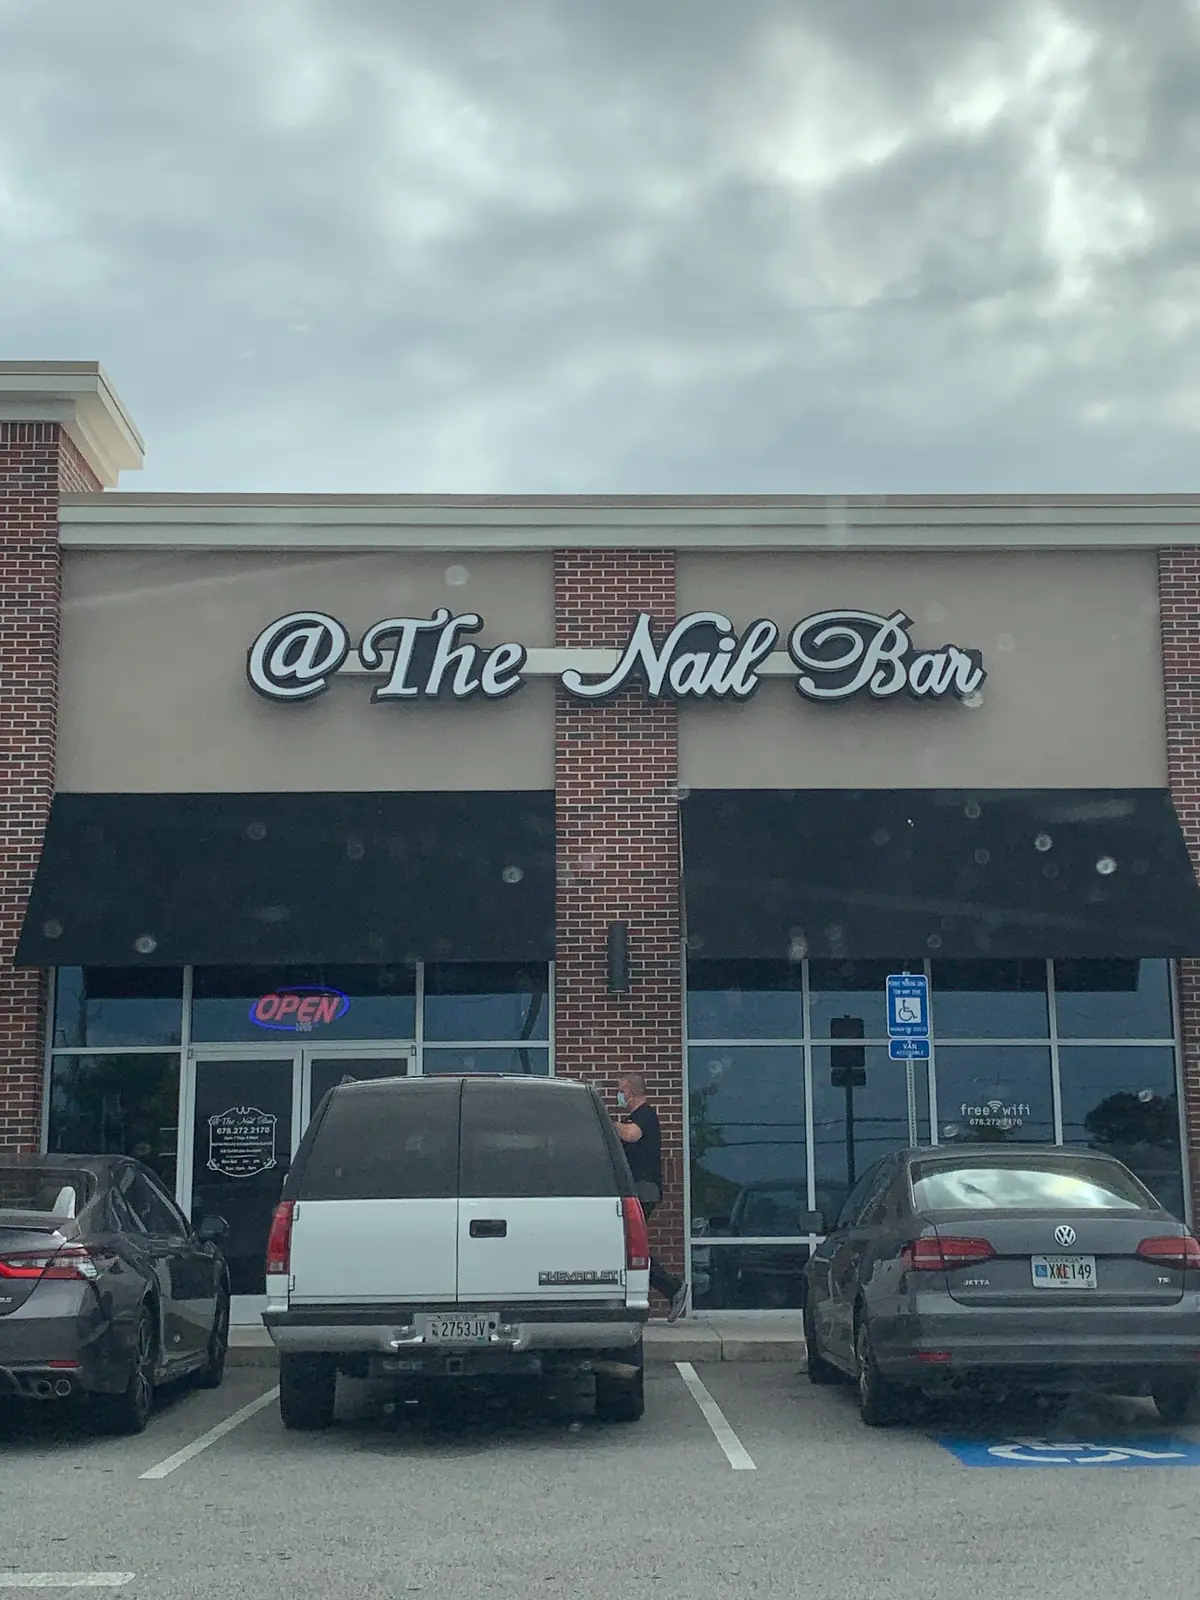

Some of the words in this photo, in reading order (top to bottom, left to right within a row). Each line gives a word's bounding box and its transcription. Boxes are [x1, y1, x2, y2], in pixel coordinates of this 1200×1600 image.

[248, 610, 347, 698] @
[360, 607, 526, 698] The
[560, 610, 780, 698] Nail
[790, 609, 985, 699] Bar
[255, 993, 340, 1024] OPEN
[960, 1103, 990, 1116] free
[1002, 1103, 1031, 1116] wifi
[539, 1270, 618, 1281] CHEVROLET
[441, 1321, 486, 1337] 2753JV
